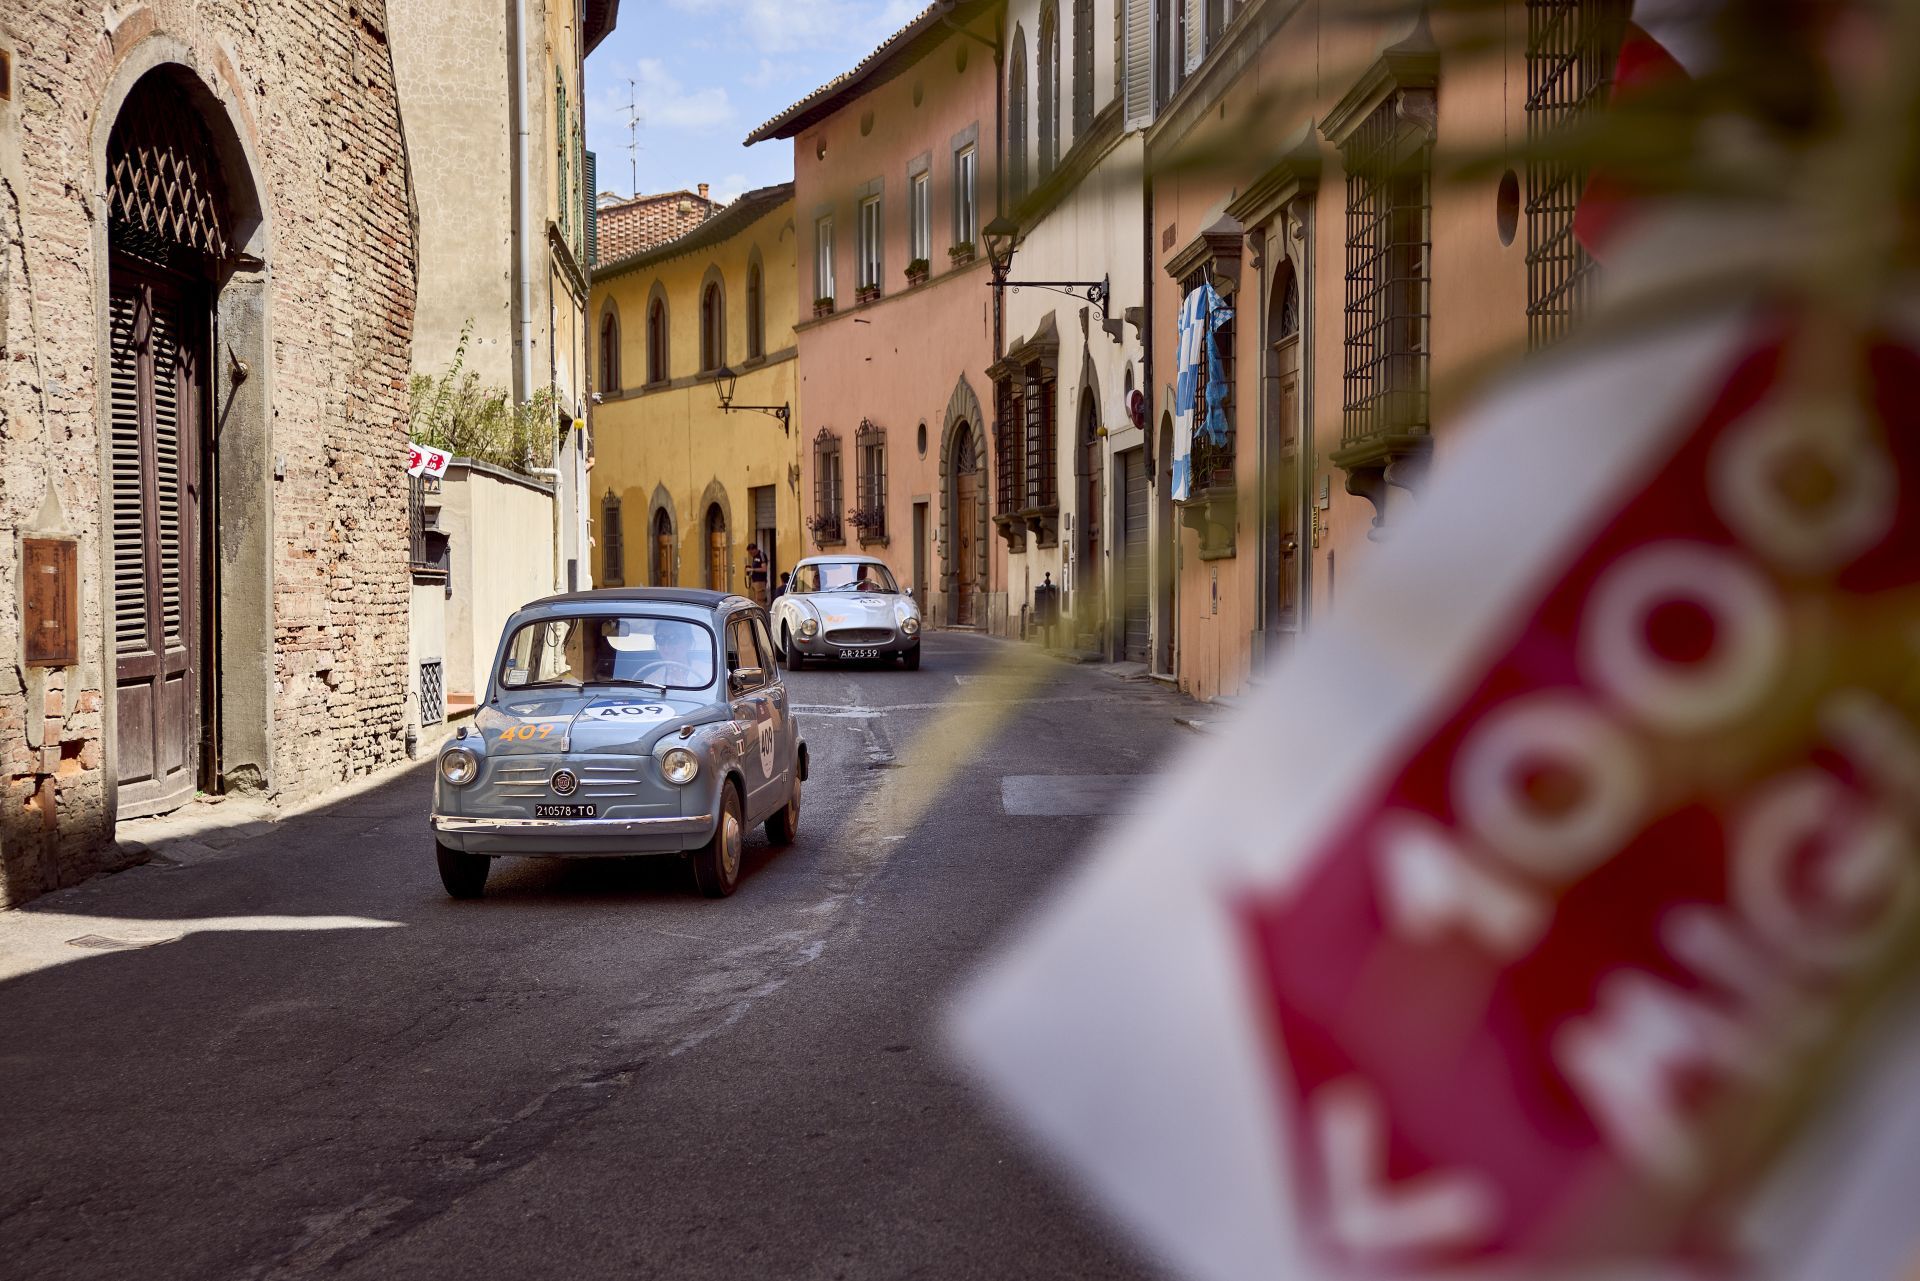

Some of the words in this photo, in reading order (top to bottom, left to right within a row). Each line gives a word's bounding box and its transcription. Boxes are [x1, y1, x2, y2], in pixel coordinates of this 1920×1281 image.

[1374, 396, 1900, 962] 1000
[600, 705, 663, 717] 409
[499, 722, 555, 742] 409
[761, 726, 773, 757] 409
[537, 805, 572, 816] 210578
